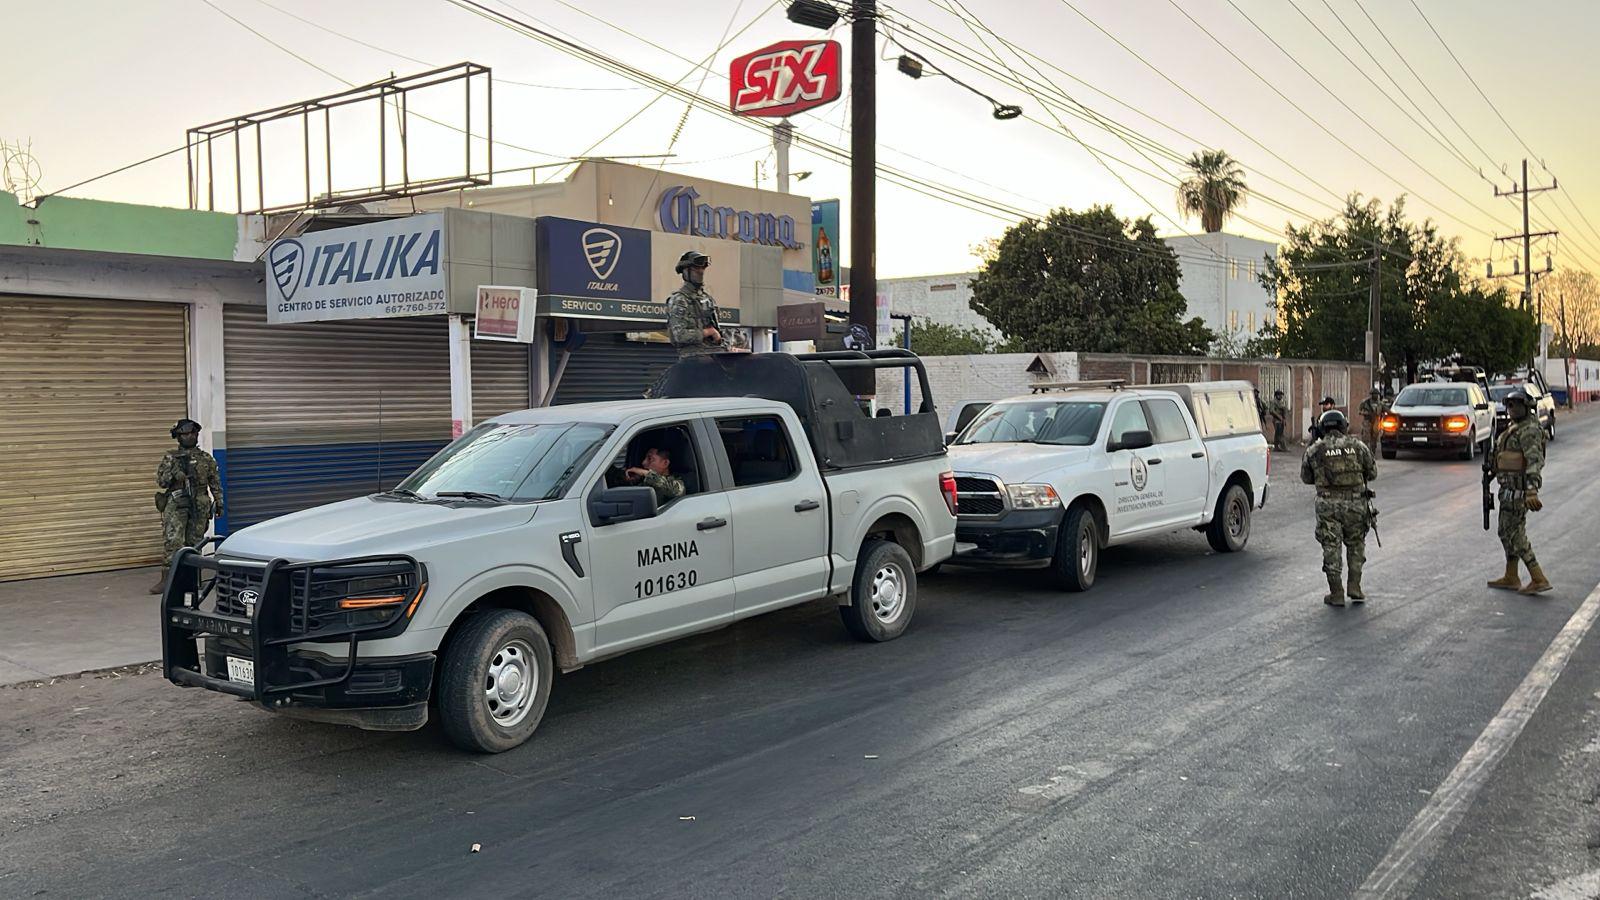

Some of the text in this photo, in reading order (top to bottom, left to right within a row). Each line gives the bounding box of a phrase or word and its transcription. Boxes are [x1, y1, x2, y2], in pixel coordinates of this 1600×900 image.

[659, 185, 800, 250] Corona
[304, 229, 441, 288] ITALIKA
[587, 281, 619, 292] ITALIKA
[278, 289, 444, 313] CENTRO DE SERVICIO AUTORIZADO
[492, 295, 520, 310] Hero
[562, 300, 602, 311] SERVICIO
[637, 540, 699, 568] MARINA
[634, 569, 697, 599] 101630
